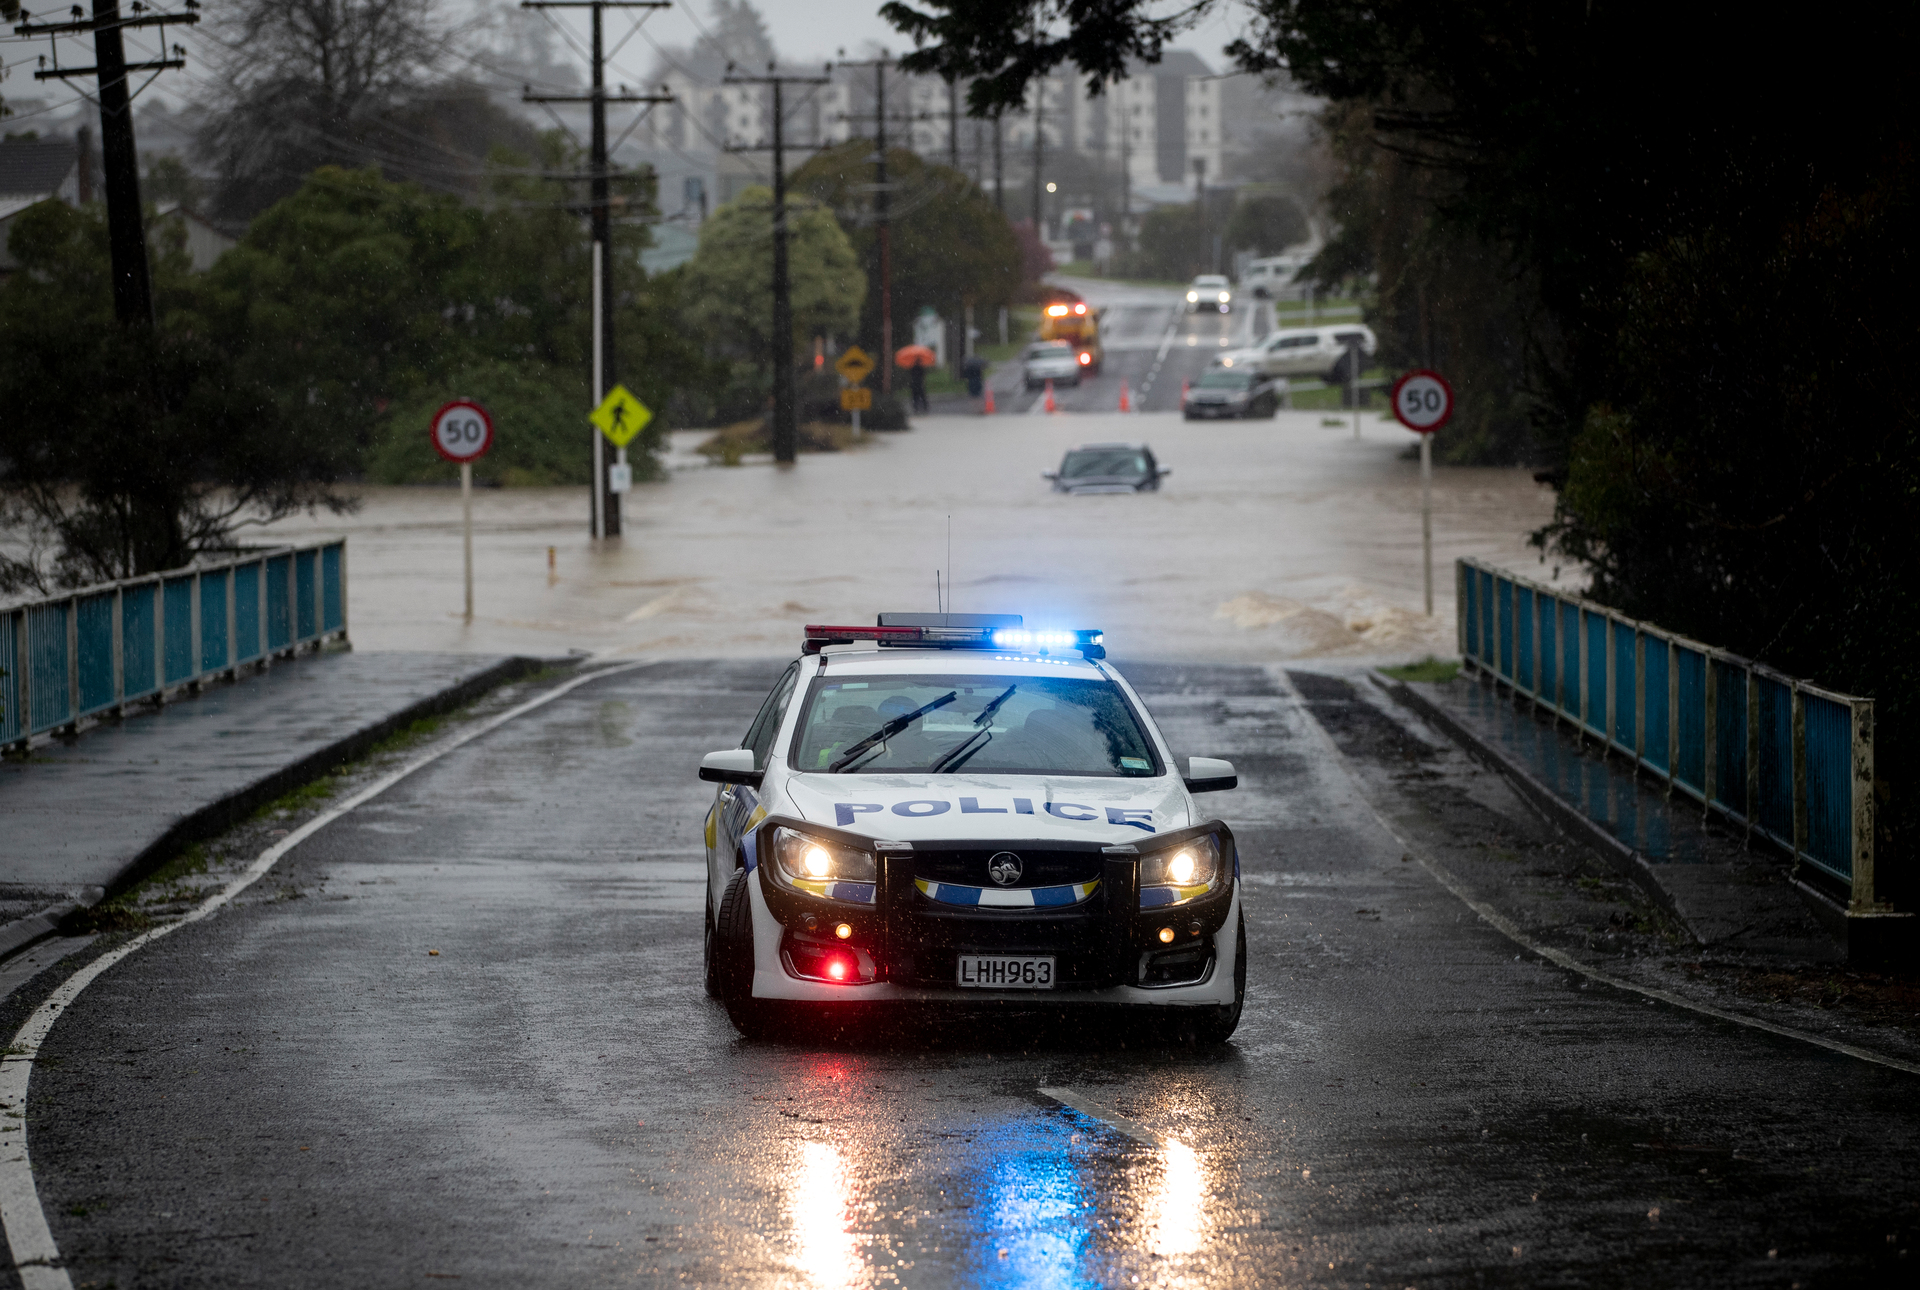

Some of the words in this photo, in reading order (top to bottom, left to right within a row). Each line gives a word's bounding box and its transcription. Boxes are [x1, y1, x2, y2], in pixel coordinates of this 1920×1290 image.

[1407, 389, 1440, 413] 50
[446, 419, 480, 443] 50
[834, 797, 1156, 833] POLICE
[962, 960, 1051, 984] LHH963
